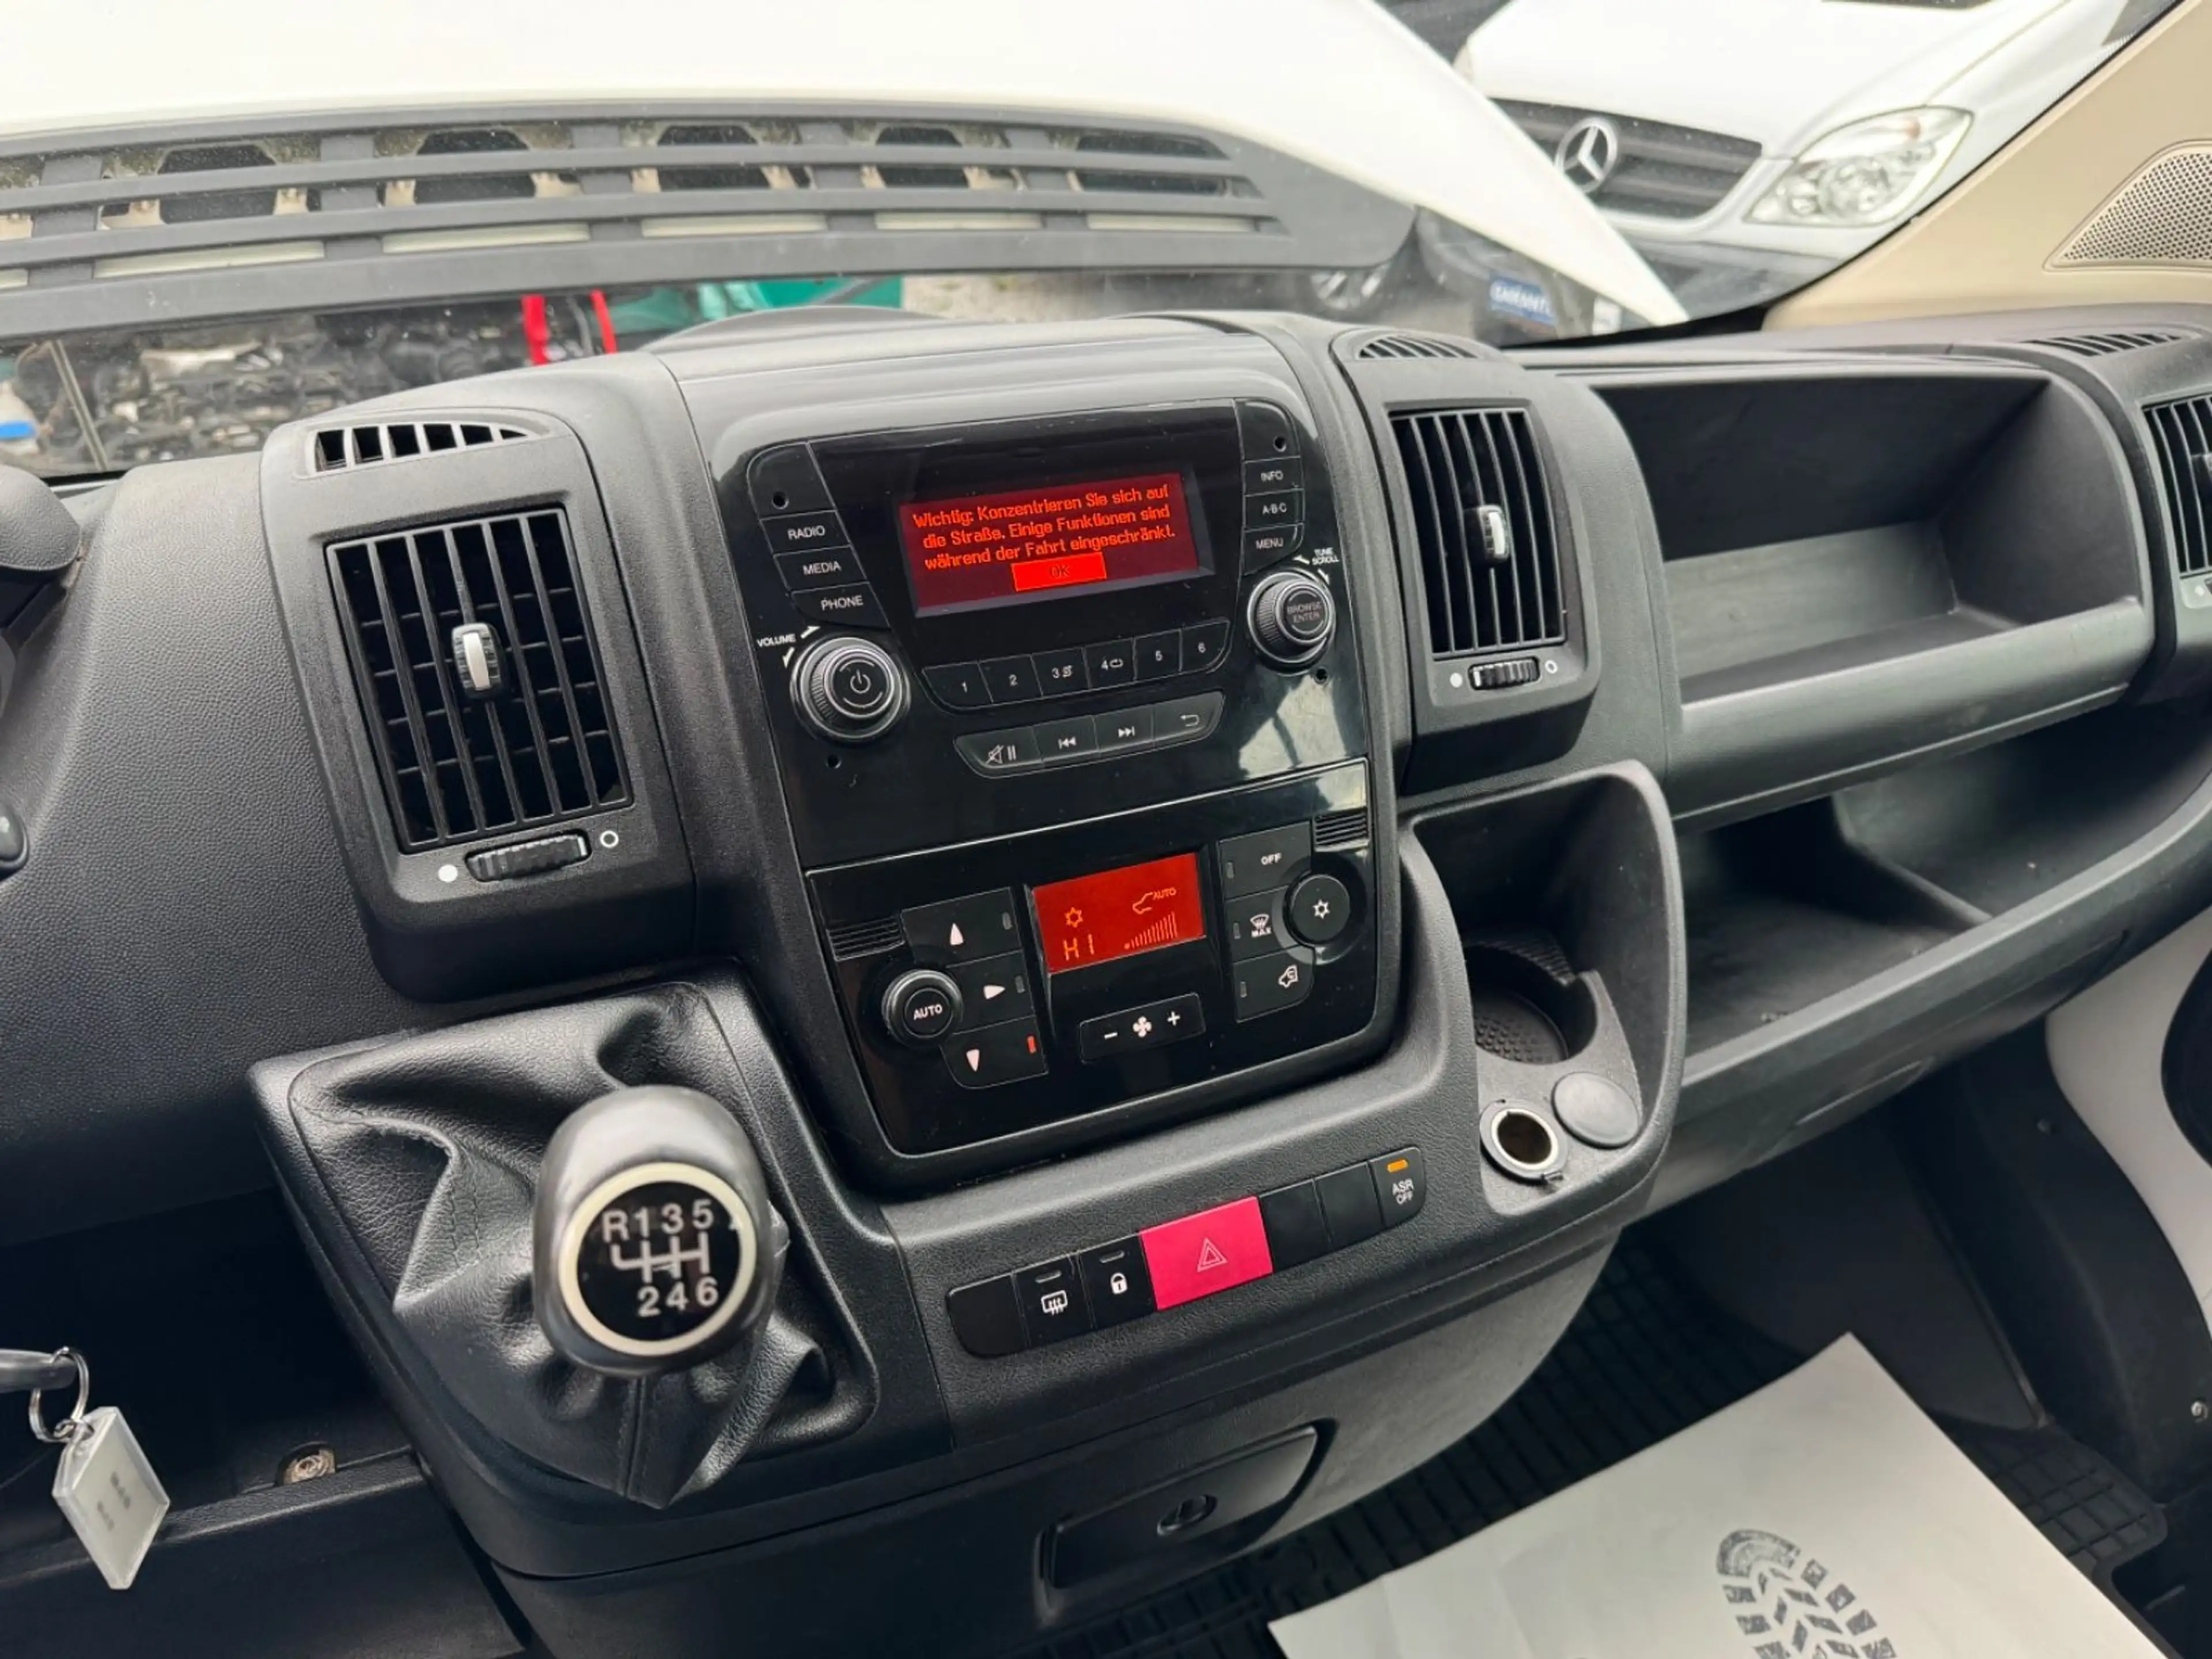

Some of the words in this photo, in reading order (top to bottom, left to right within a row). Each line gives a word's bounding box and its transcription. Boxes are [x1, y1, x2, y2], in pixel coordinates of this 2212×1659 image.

[1260, 469, 1284, 482] INFO
[912, 510, 974, 528] Wichtig:
[977, 499, 1082, 521] Konzentrieren
[1085, 492, 1107, 507] Sie
[1112, 488, 1142, 504] sich
[1146, 484, 1169, 498] auf
[787, 525, 825, 540] RADIO
[923, 531, 946, 548] die
[951, 525, 1006, 546] Straße.
[1009, 521, 1052, 538] Einige
[1057, 512, 1136, 531] Funktionen
[1141, 505, 1171, 521] sind
[925, 548, 991, 570] während
[995, 546, 1020, 560] der
[1025, 538, 1066, 558] Fahrt
[1071, 525, 1175, 551] eingeschränkt.
[1255, 537, 1283, 551] MENU
[1312, 555, 1339, 565] SCROLL
[802, 561, 842, 575] MEDIA
[1049, 564, 1071, 578] OK
[821, 595, 863, 611] PHONE
[756, 634, 796, 647] VOLUME
[961, 681, 968, 692] 1
[1009, 674, 1018, 686] 2
[1052, 667, 1060, 679] 3
[1101, 660, 1108, 671] 4
[1156, 650, 1162, 661] 5
[1198, 642, 1206, 653] 6
[1261, 853, 1282, 865] OFF
[1153, 887, 1176, 900] AUTO
[913, 1003, 942, 1021] AUTO
[1392, 1179, 1414, 1195] ASR
[1395, 1190, 1414, 1205] OFF
[602, 1209, 629, 1243] R
[634, 1207, 649, 1237] 1
[661, 1202, 684, 1234] 3
[692, 1198, 714, 1229] 5
[637, 1285, 661, 1317] 2
[666, 1281, 688, 1310] 4
[696, 1275, 719, 1307] 6
